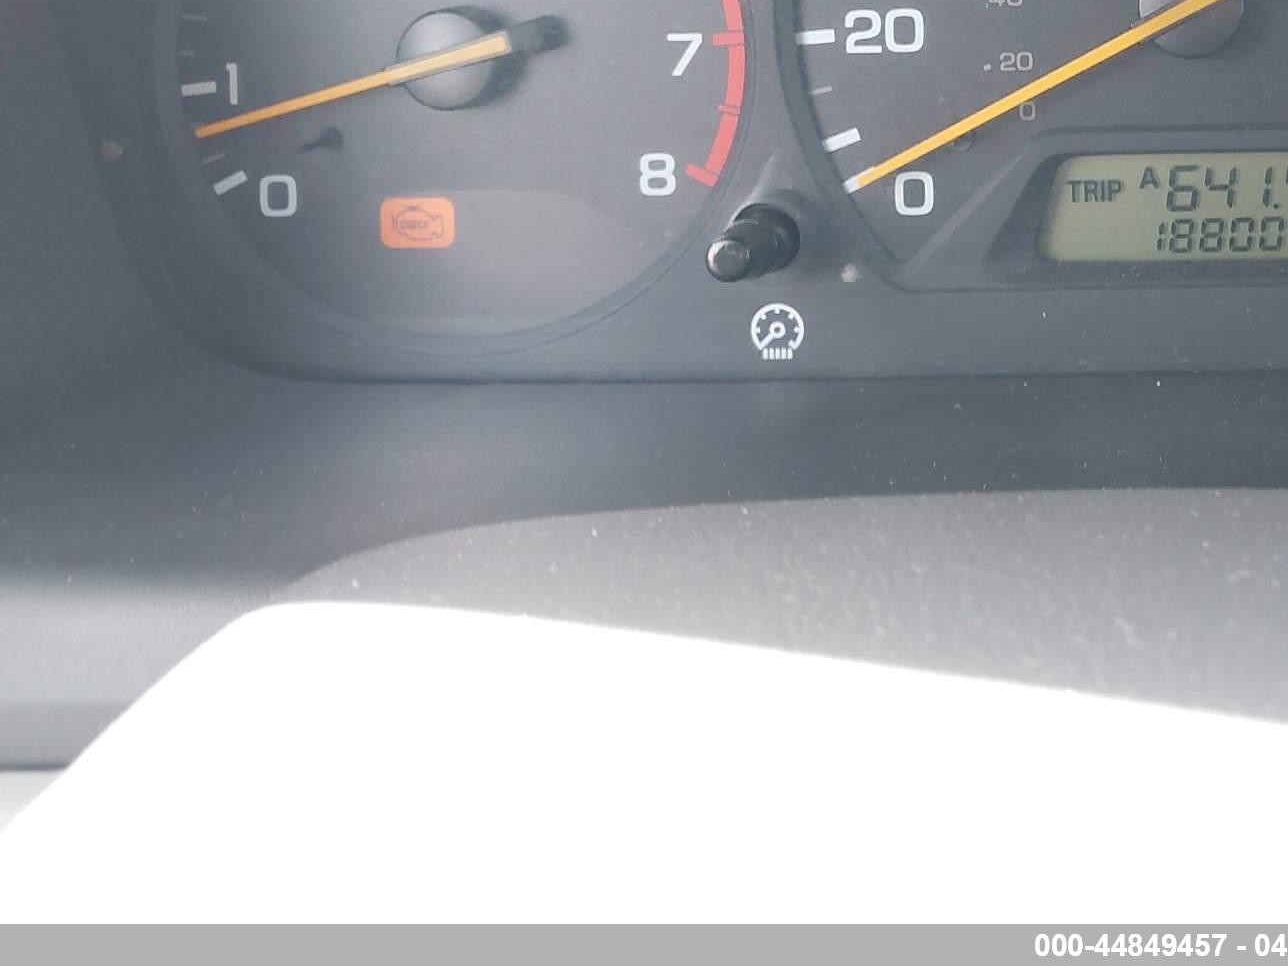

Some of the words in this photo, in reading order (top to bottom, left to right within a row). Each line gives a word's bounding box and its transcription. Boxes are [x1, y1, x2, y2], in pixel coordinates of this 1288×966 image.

[845, 8, 924, 54] 20
[667, 34, 702, 76] 7
[1000, 52, 1034, 71] 20
[226, 63, 238, 105] 1
[1019, 101, 1036, 121] 0
[639, 153, 676, 195] 8
[895, 171, 934, 216] 0
[1067, 180, 1125, 203] TRIP
[1139, 166, 1159, 189] A
[260, 174, 297, 217] 0
